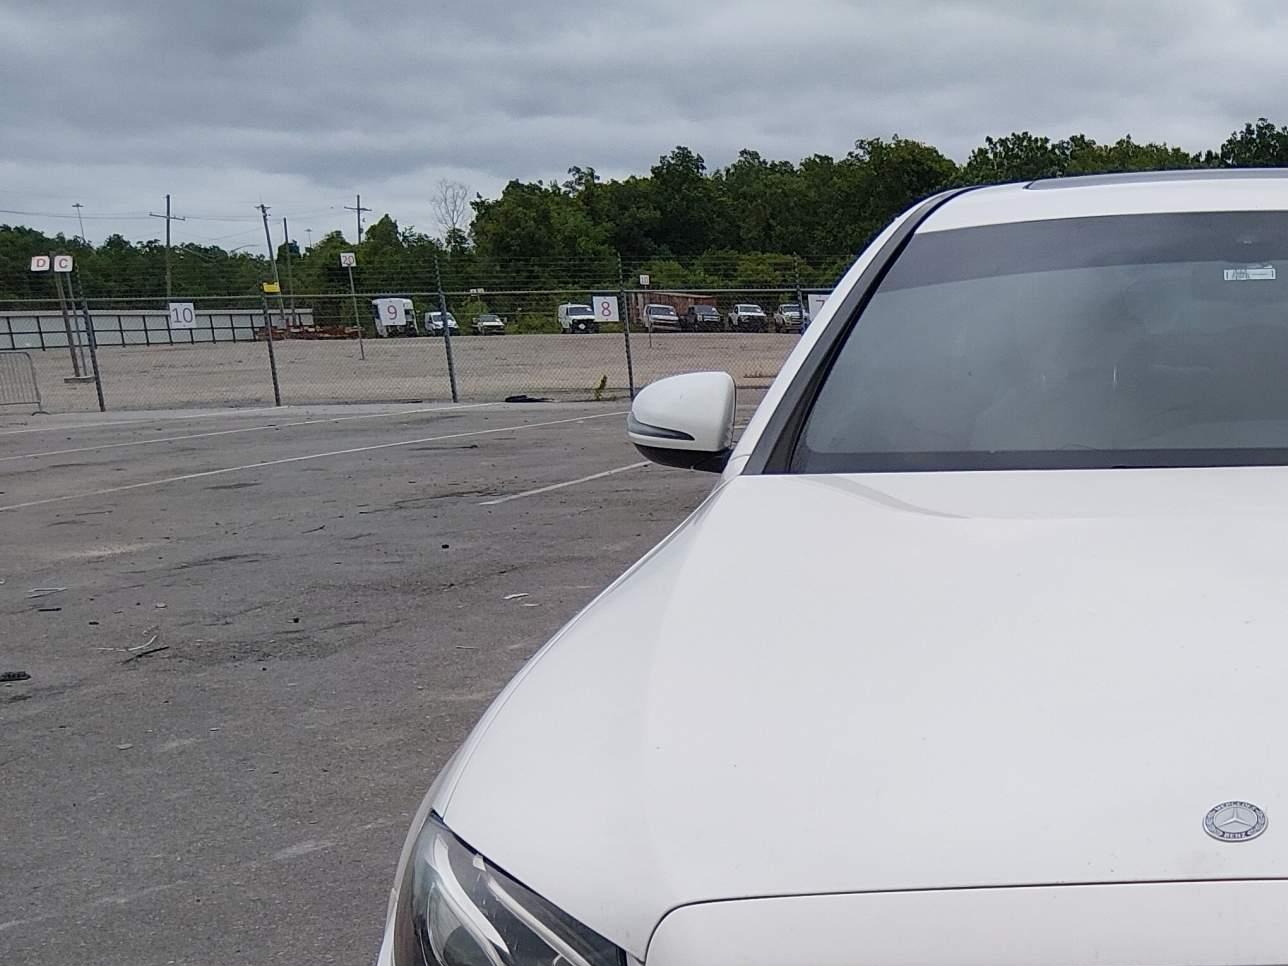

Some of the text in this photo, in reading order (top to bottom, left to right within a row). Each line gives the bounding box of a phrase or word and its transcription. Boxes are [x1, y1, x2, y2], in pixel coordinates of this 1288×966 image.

[36, 258, 46, 268] D
[58, 258, 68, 269] C
[342, 255, 355, 266] 20
[172, 307, 193, 323] 10
[387, 304, 398, 320] 9
[601, 301, 612, 317] 8
